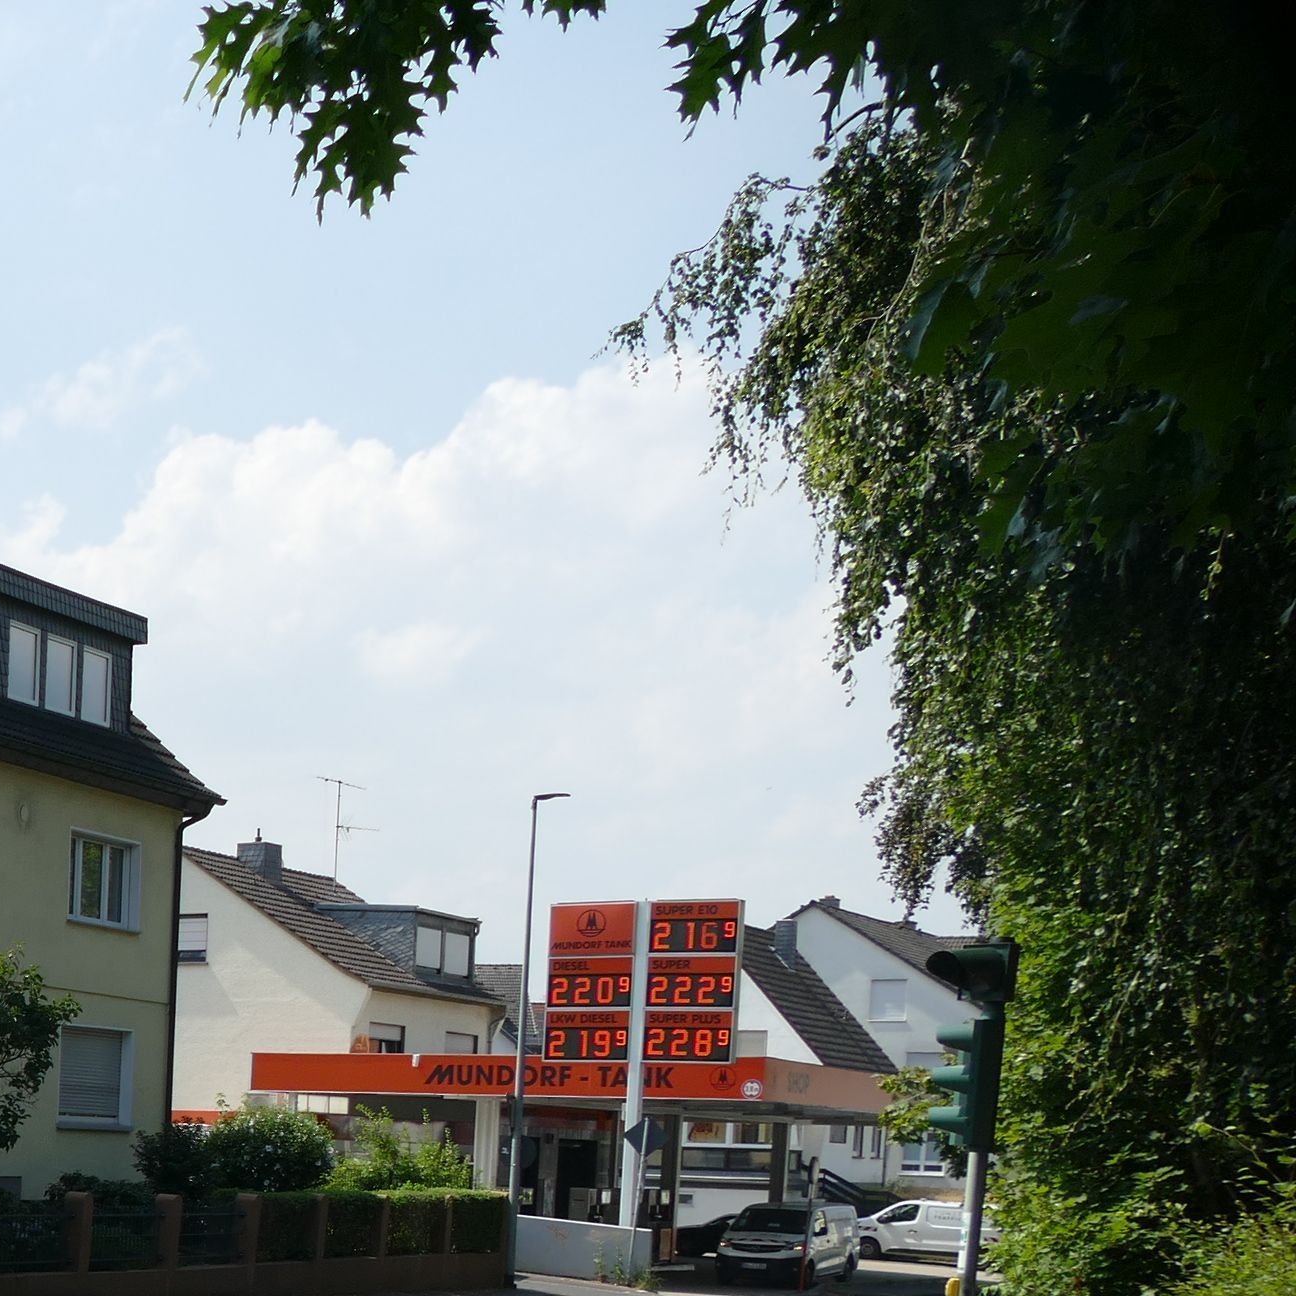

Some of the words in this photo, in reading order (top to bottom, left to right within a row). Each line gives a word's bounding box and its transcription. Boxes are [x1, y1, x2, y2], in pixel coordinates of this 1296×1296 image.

[655, 905, 693, 915] SUPER
[698, 905, 718, 915] E10
[551, 941, 603, 950] MUNDORF
[605, 940, 632, 949] TANK
[552, 961, 590, 971] DIESEL
[652, 960, 691, 970] SUPER
[550, 1014, 576, 1024] LKW
[580, 1014, 618, 1024] DIESEL
[649, 1014, 687, 1024] SUPER
[691, 1014, 721, 1024] PLUS
[424, 1064, 571, 1088] MUNDORF
[597, 1066, 674, 1090] TANK
